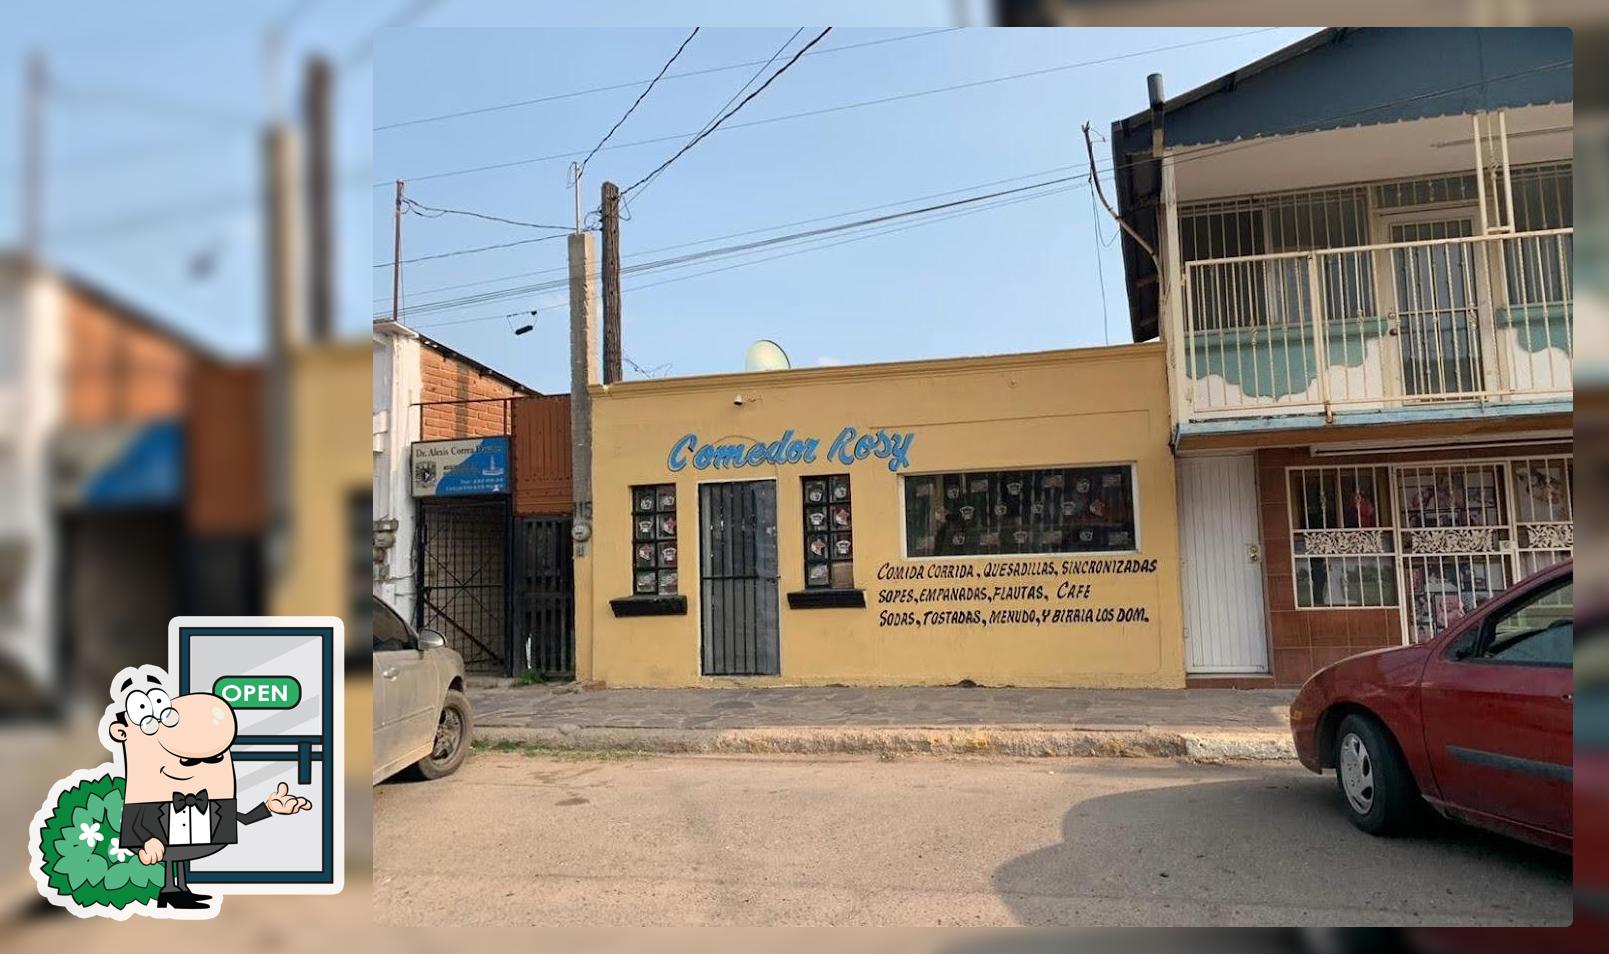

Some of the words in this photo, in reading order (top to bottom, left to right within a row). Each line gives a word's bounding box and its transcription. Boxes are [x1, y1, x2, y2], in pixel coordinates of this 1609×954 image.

[415, 448, 427, 458] Dr.
[428, 447, 449, 457] Alexis
[667, 430, 820, 472] Comedor
[827, 427, 915, 472] Rosy
[877, 562, 924, 580] COMIDA
[1062, 559, 1157, 575] SINCRONIZADAS
[1057, 581, 1091, 599] CAFE
[1052, 608, 1094, 623] BIRRIA
[1095, 608, 1115, 622] LOS
[1116, 607, 1150, 622] DOM.
